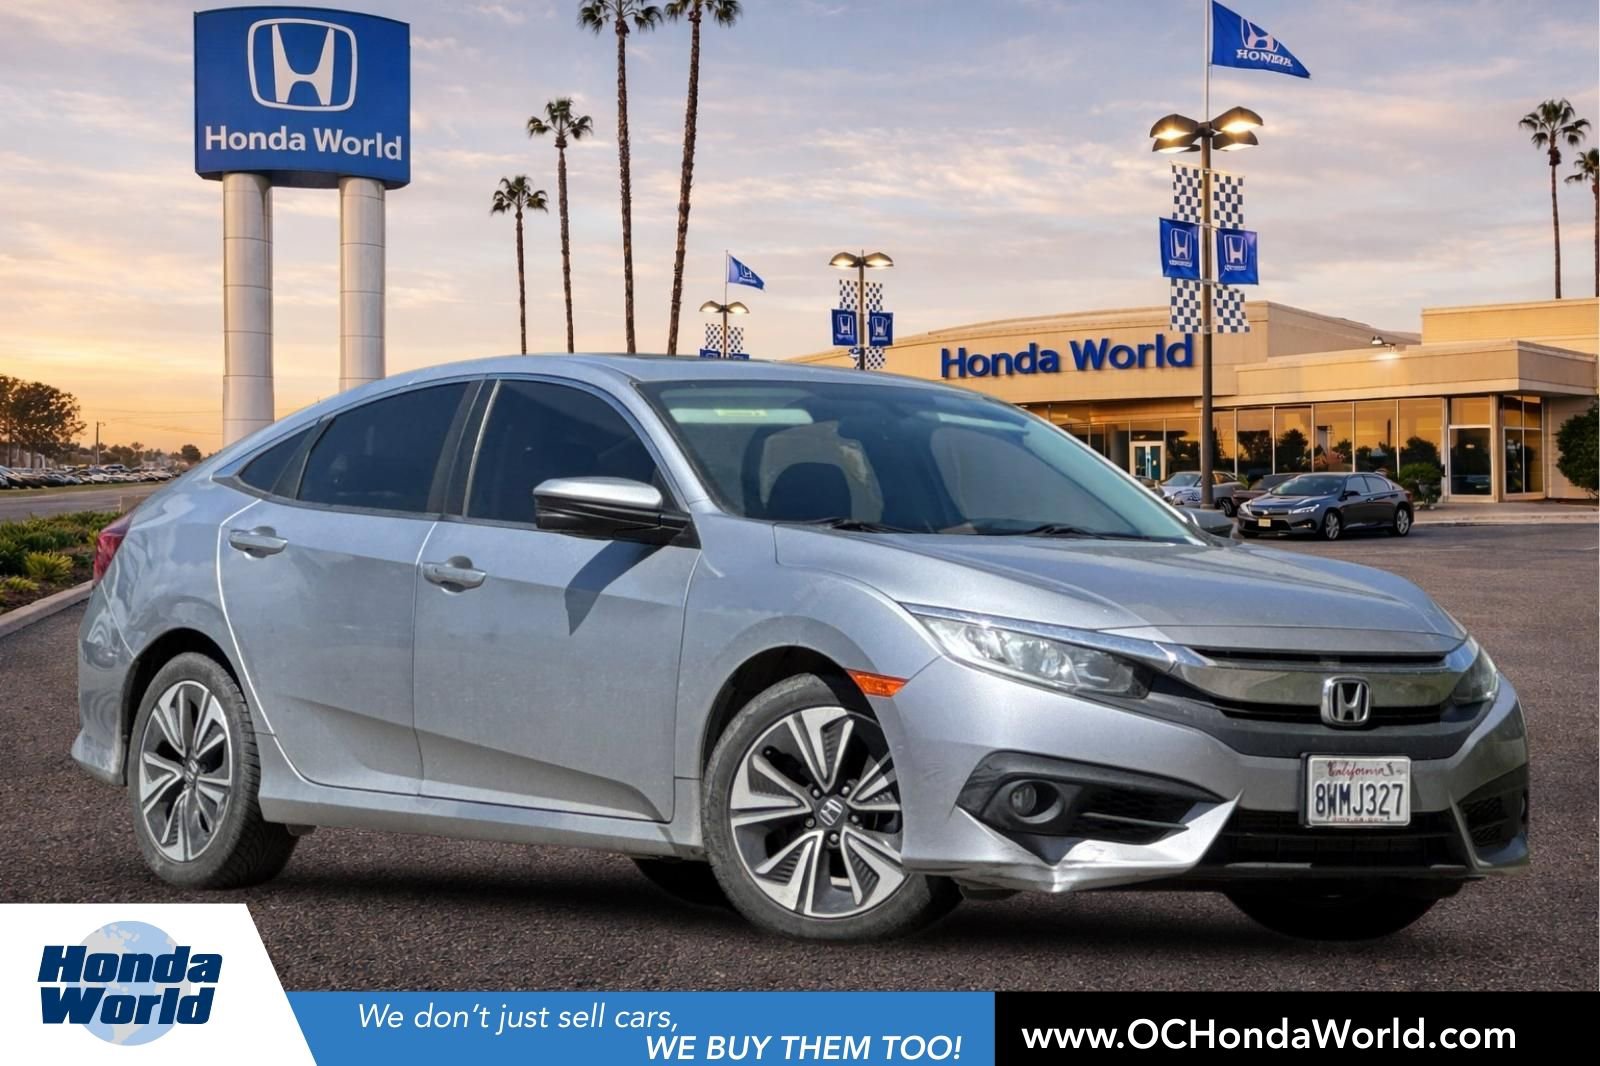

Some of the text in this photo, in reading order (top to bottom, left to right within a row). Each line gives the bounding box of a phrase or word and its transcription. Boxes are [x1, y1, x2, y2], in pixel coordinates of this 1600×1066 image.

[205, 125, 402, 161] Honda World
[941, 333, 1194, 378] Honda World
[1315, 783, 1404, 817] 8WMJ327
